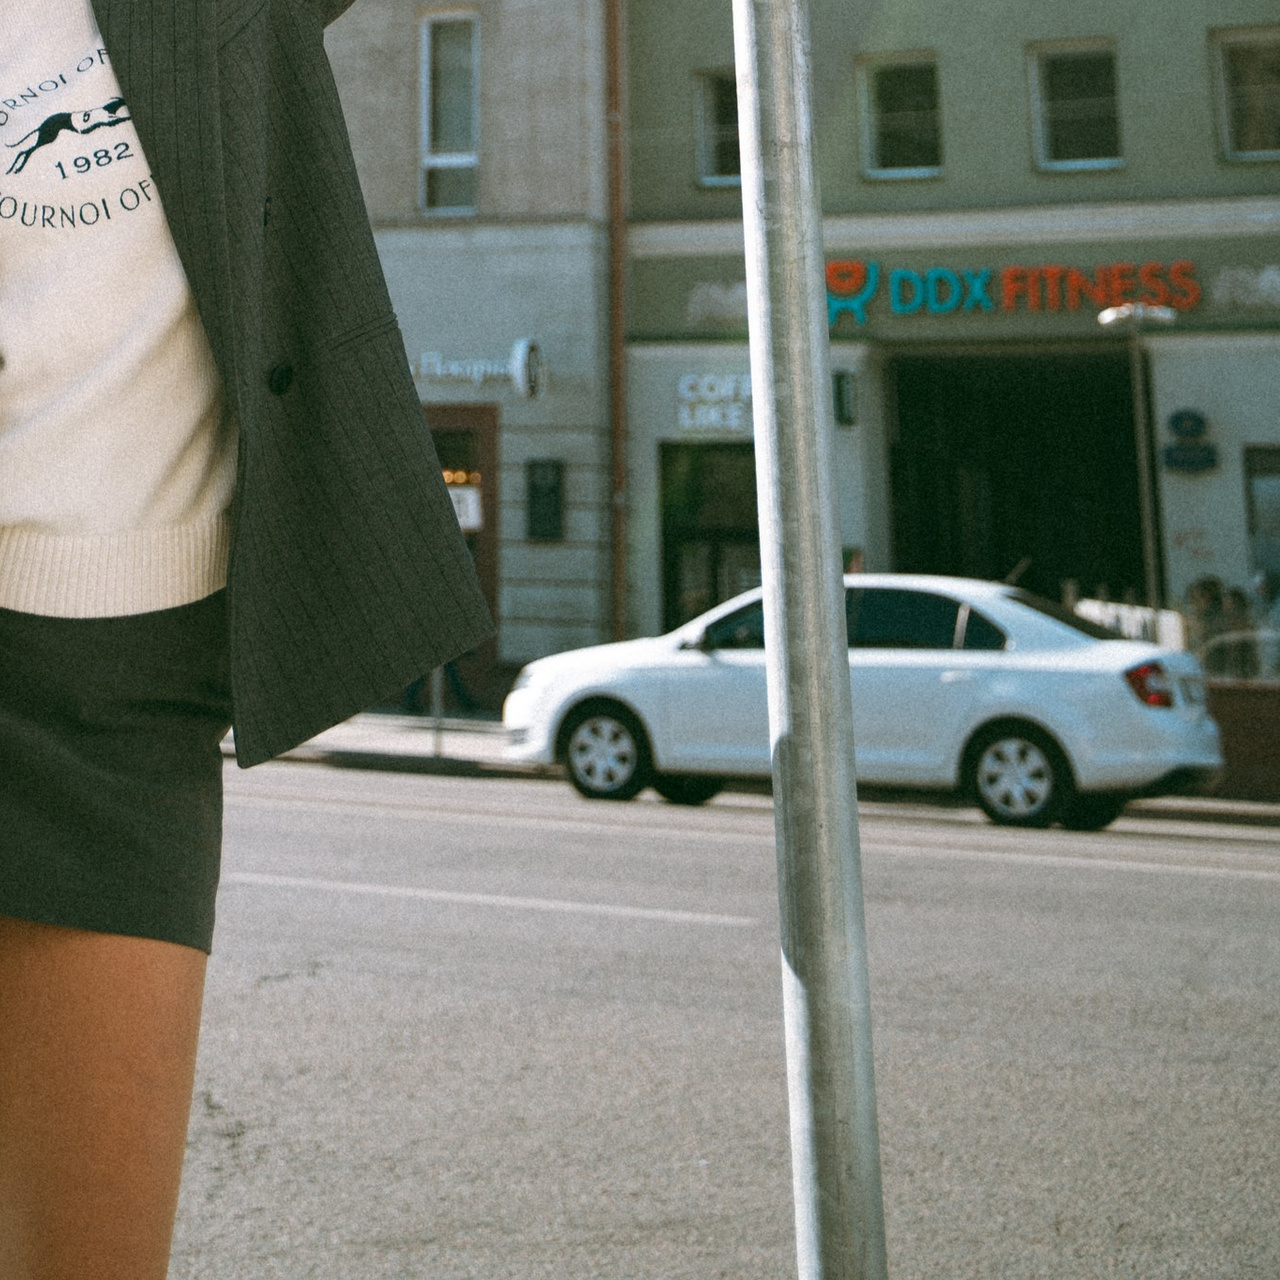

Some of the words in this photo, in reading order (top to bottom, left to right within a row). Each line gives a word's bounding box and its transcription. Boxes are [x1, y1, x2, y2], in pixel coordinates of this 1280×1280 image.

[77, 48, 109, 73] OF
[55, 142, 134, 180] 1982
[120, 179, 152, 211] OF
[888, 268, 993, 315] DDX
[1001, 260, 1202, 312] FITNESS
